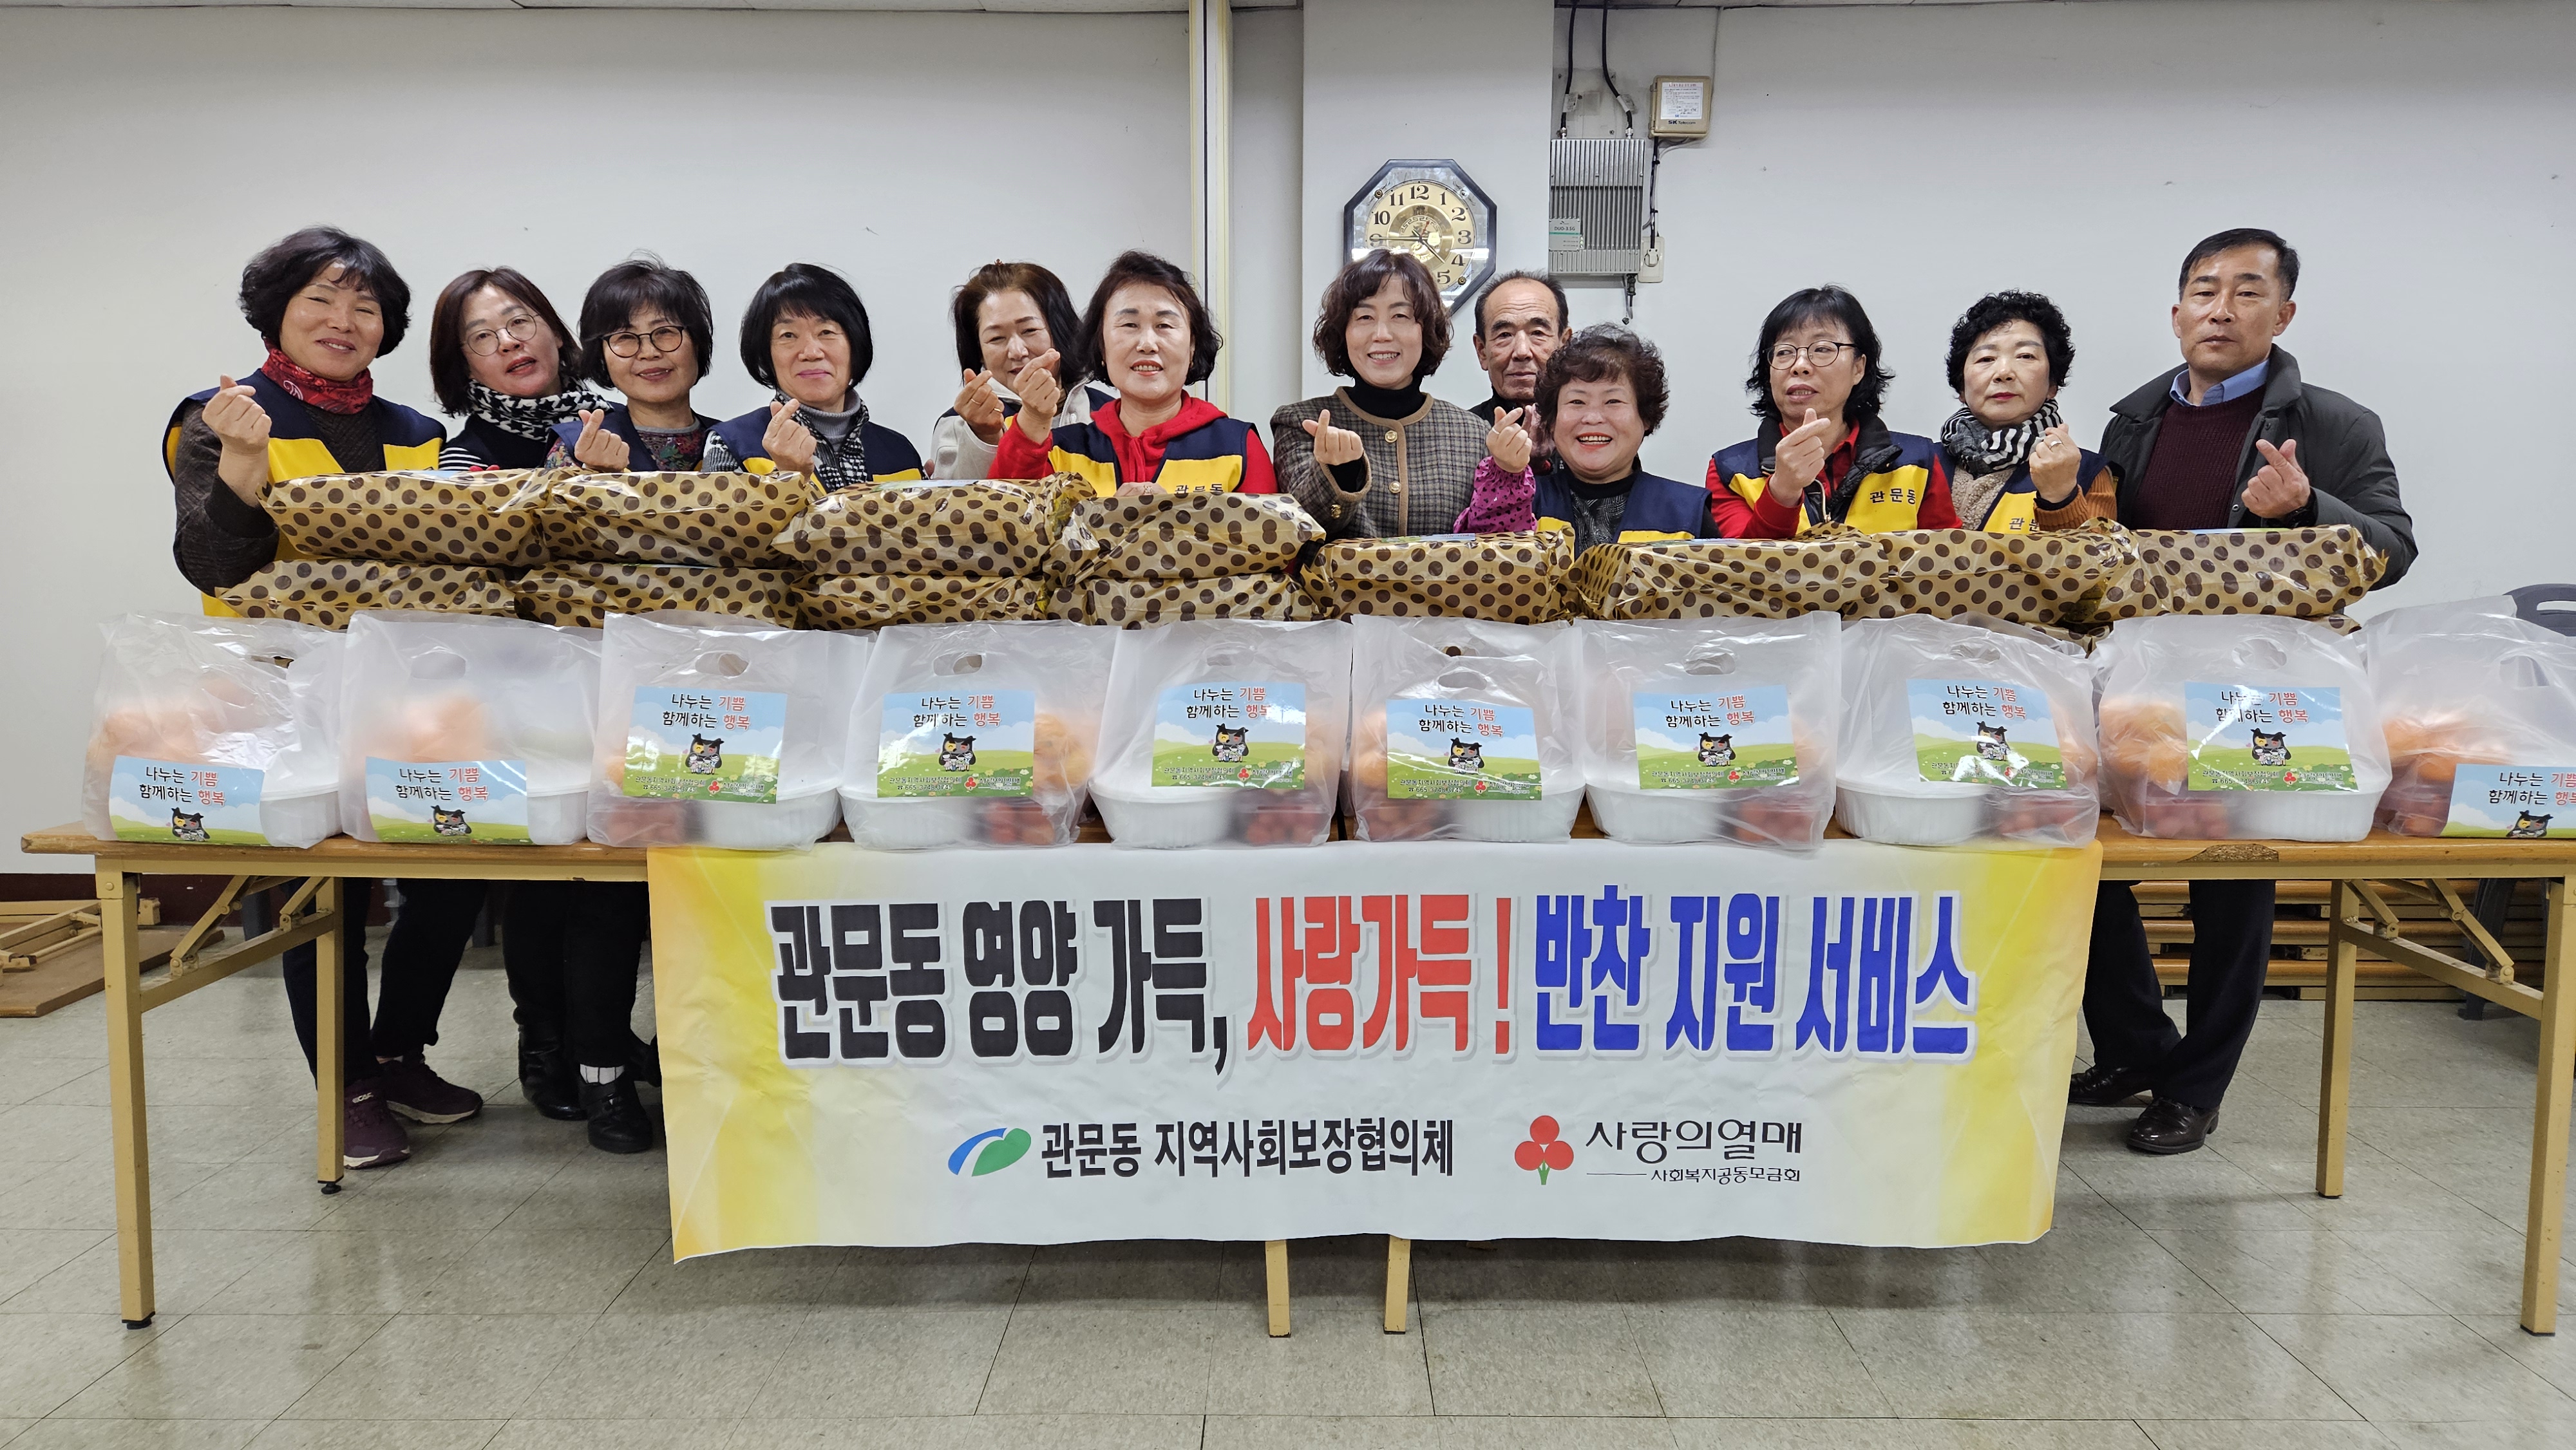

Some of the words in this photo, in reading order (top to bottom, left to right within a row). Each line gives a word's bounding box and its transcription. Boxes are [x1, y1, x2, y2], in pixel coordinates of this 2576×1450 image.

[1390, 192, 1405, 206] 11
[1410, 185, 1430, 200] 12
[1439, 191, 1446, 205] 1
[1374, 211, 1390, 225] 10
[1452, 207, 1466, 221] 2
[1457, 230, 1472, 245] 3
[1451, 254, 1466, 267] 4
[1437, 269, 1451, 285] 5
[1870, 488, 1916, 505] 관문동
[672, 693, 712, 710] 나누는
[718, 696, 745, 711] 기쁨
[1193, 688, 1233, 701] 나누는
[1239, 687, 1266, 701] 기쁨
[1947, 685, 1988, 699] 나누는
[1993, 687, 2016, 702] 기쁨
[2269, 692, 2298, 706] 기쁨
[922, 696, 961, 710] 나누는
[967, 695, 994, 710] 기쁨
[1671, 699, 1712, 712] 나누는
[1718, 695, 1745, 710] 기쁨
[1942, 701, 1997, 717] 함께하는
[2002, 704, 2027, 720] 행복
[974, 712, 1001, 727] 행복
[1186, 704, 1240, 719] 함께하는
[1425, 704, 1465, 718] 나누는
[1470, 708, 1495, 721] 기쁨
[1665, 715, 1721, 728] 함께하는
[1727, 710, 1755, 726] 행복
[2278, 709, 2309, 724] 행복
[663, 711, 717, 728] 함께하는
[723, 714, 750, 730] 행복
[1419, 719, 1473, 735] 함께하는
[1477, 723, 1504, 737] 행복
[146, 766, 185, 784] 나누는
[191, 771, 218, 787] 기쁨
[399, 768, 442, 783] 나누는
[449, 767, 479, 783] 기쁨
[2499, 771, 2544, 787] 나누는
[2550, 773, 2576, 788] 기쁨
[139, 784, 193, 803] 함께하는
[198, 789, 225, 805] 행복
[395, 785, 452, 800] 함께하는
[457, 786, 488, 802] 행복
[2489, 789, 2548, 805] 함께하는
[770, 902, 947, 1060] 관문동
[961, 899, 1077, 1058] 영양
[1093, 898, 1229, 1077] 가득,
[1534, 884, 1651, 1052] 반찬
[1665, 892, 1779, 1052] 지원
[1795, 895, 1975, 1055] 서비스
[1041, 1121, 1142, 1179] 관문동
[1153, 1117, 1455, 1179] 지역사회보장협의체
[1585, 1116, 1803, 1166] 사랑의열매
[1650, 1165, 1802, 1186] 사회복지공동모금회
